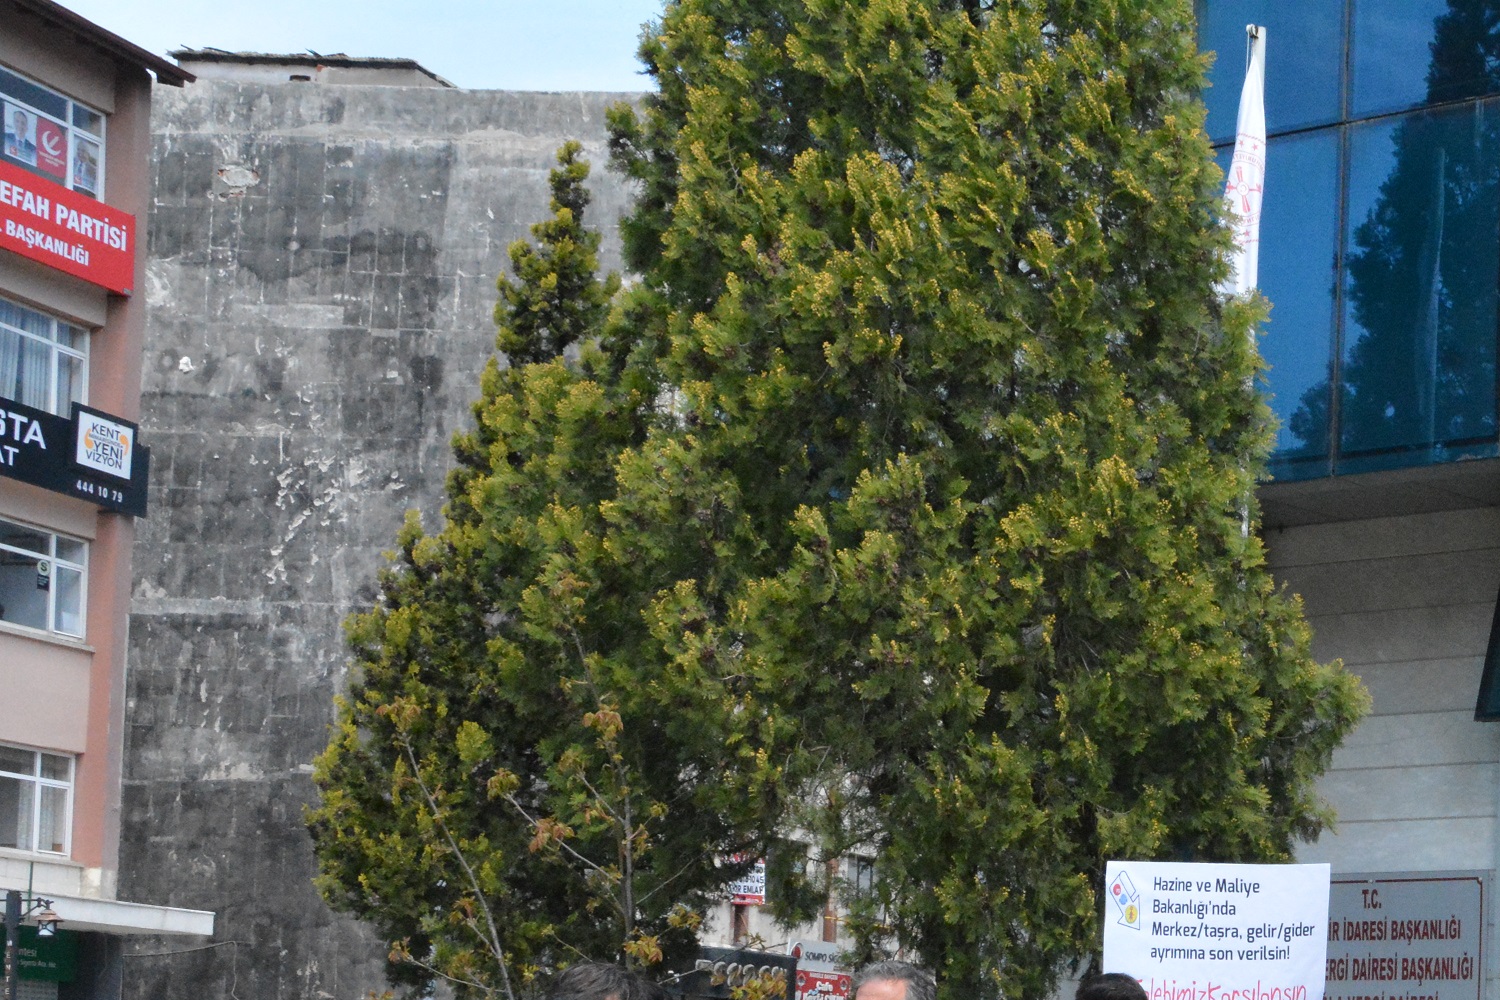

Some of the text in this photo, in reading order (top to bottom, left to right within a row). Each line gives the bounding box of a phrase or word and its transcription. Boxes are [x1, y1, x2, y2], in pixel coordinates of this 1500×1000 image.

[0, 179, 127, 252] EFAH PARTİSİ
[5, 218, 90, 267] BAŞKANLIĞI
[92, 422, 121, 441] KENT
[86, 449, 122, 470] VİZYON
[76, 480, 123, 503] 444 10 79
[1154, 876, 1260, 898] Hazine ve Maliye
[1152, 898, 1237, 920] Bakanlığı'nda
[1361, 888, 1382, 909] T.C.
[1151, 922, 1315, 943] Merkez/taşra, gelir/gider
[1343, 916, 1387, 941] İDARESİ
[1391, 914, 1461, 945] BAŞKANLIĞI
[1150, 946, 1290, 963] ayrımına son verilsin!
[1352, 952, 1397, 981] DAİRESİ
[1401, 951, 1473, 986] BAŞKANLIĞI
